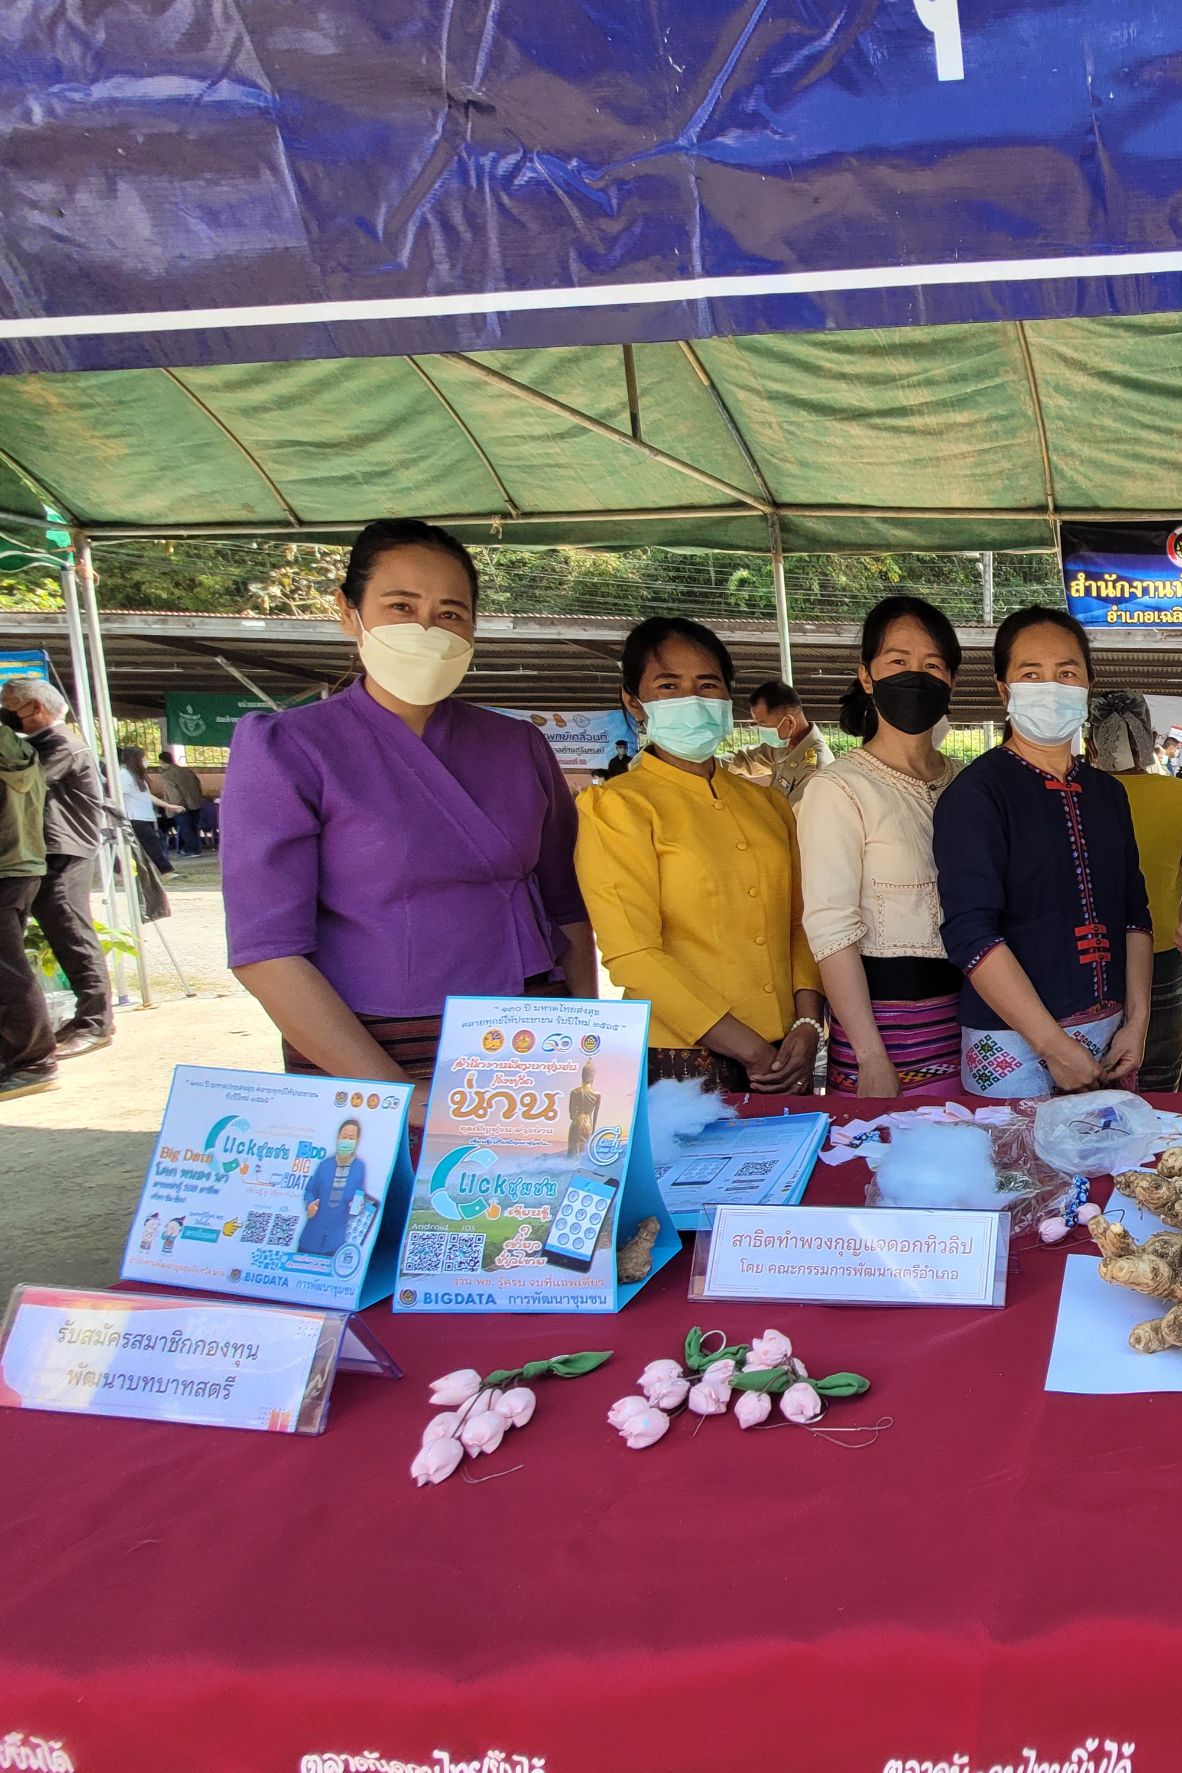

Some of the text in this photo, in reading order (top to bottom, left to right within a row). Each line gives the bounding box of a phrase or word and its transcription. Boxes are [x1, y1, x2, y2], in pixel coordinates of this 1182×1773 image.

[450, 1073, 563, 1121] น่าน
[732, 1229, 975, 1257] สาธิตทำพวงกุญแจดอกทิวลิป
[245, 1272, 289, 1287] BIGDATA
[740, 1257, 959, 1281] โดย คณะกรรมการพัฒนาสตรีอำเภอ
[423, 1290, 608, 1309] BIGDATA การพัฒนาชุมชน
[57, 1319, 260, 1368] รับสมัครสมาชิกกองทุน
[67, 1364, 237, 1401] พัฒนาบทบาทสตรี
